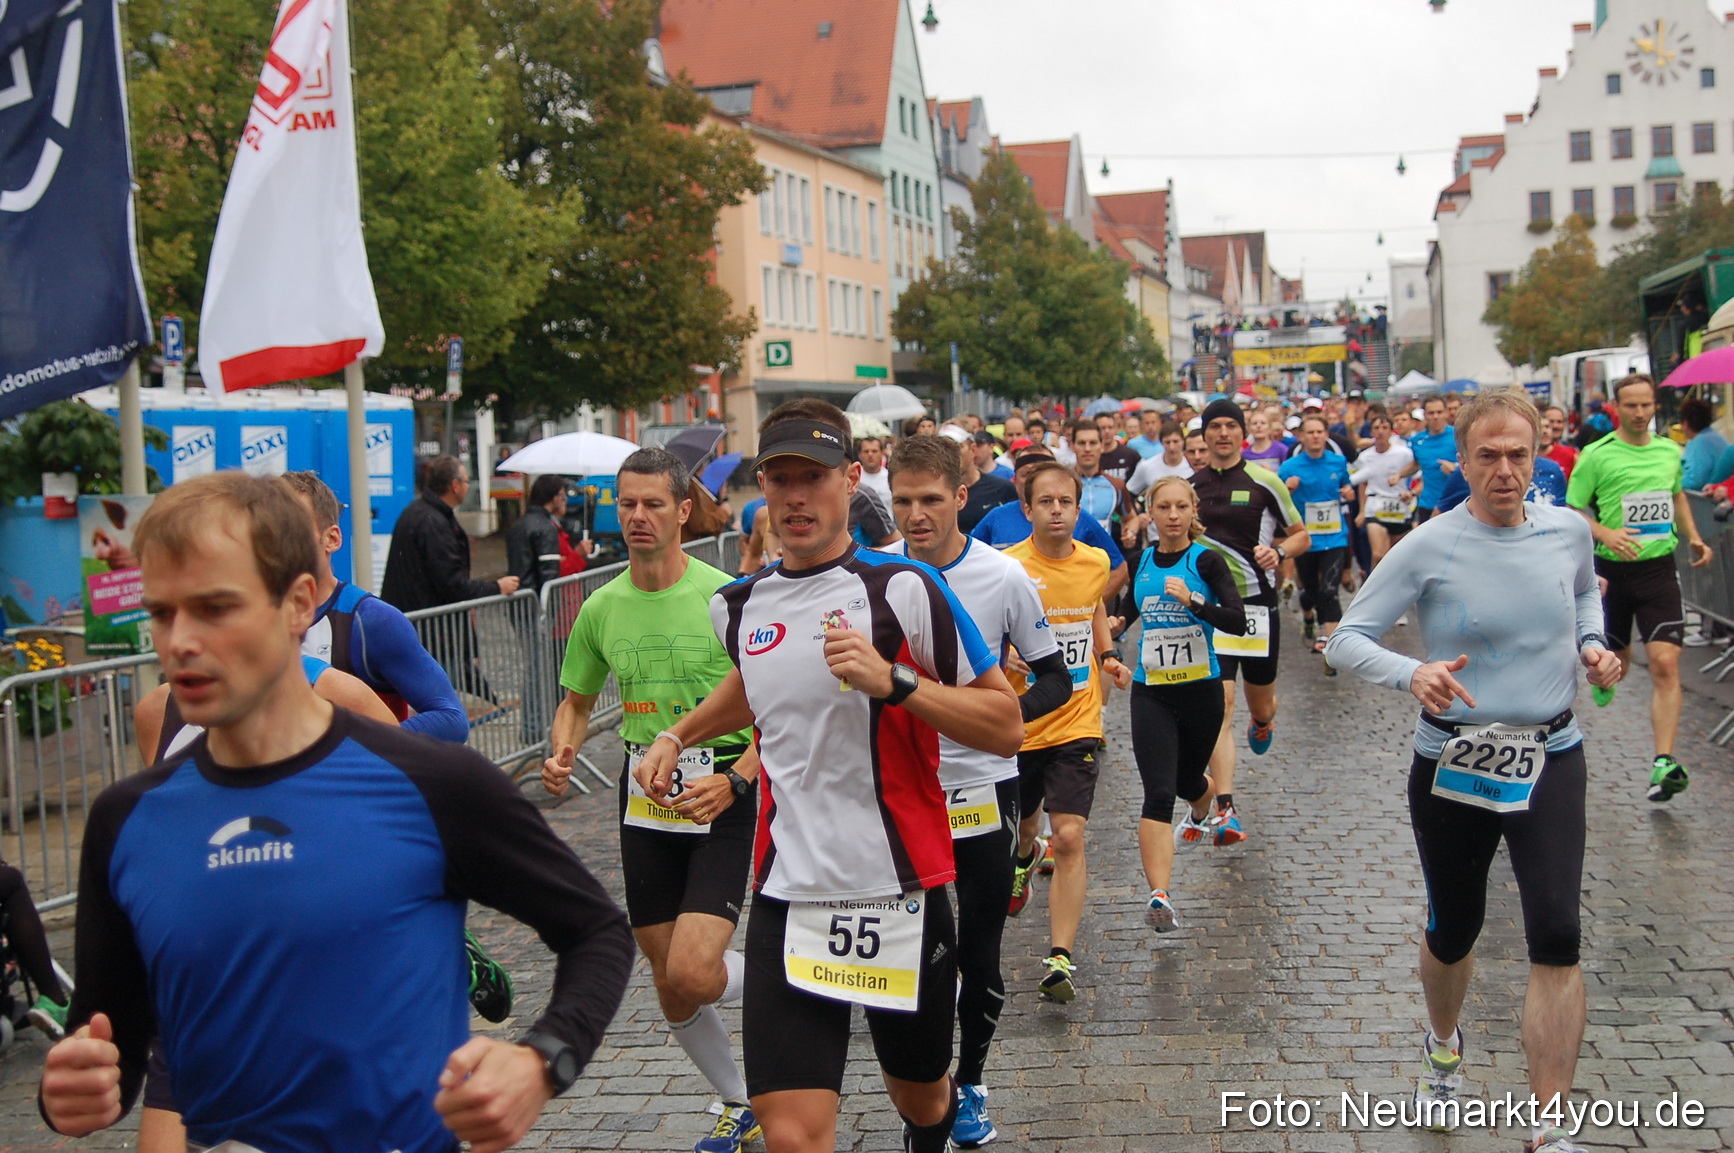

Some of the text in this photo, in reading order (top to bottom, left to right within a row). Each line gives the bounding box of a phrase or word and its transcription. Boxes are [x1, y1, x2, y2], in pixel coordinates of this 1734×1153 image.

[166, 323, 180, 357] P
[768, 343, 789, 365] D
[366, 429, 391, 449] IXI
[1317, 510, 1330, 522] 87
[1628, 502, 1670, 523] 2228
[748, 628, 774, 646] tkn
[1055, 629, 1084, 638] Neumarkt
[1163, 632, 1194, 640] Neumarkt
[1154, 641, 1194, 667] 171
[1165, 671, 1188, 682] Lena
[1486, 730, 1531, 742] Neumarkt
[1450, 739, 1536, 779] 2225
[1472, 779, 1501, 798] Uwe
[948, 812, 981, 829] gang
[207, 841, 294, 869] skinfit
[839, 900, 901, 912] Neumarkt
[827, 913, 881, 960] 55
[812, 965, 888, 991] Christian
